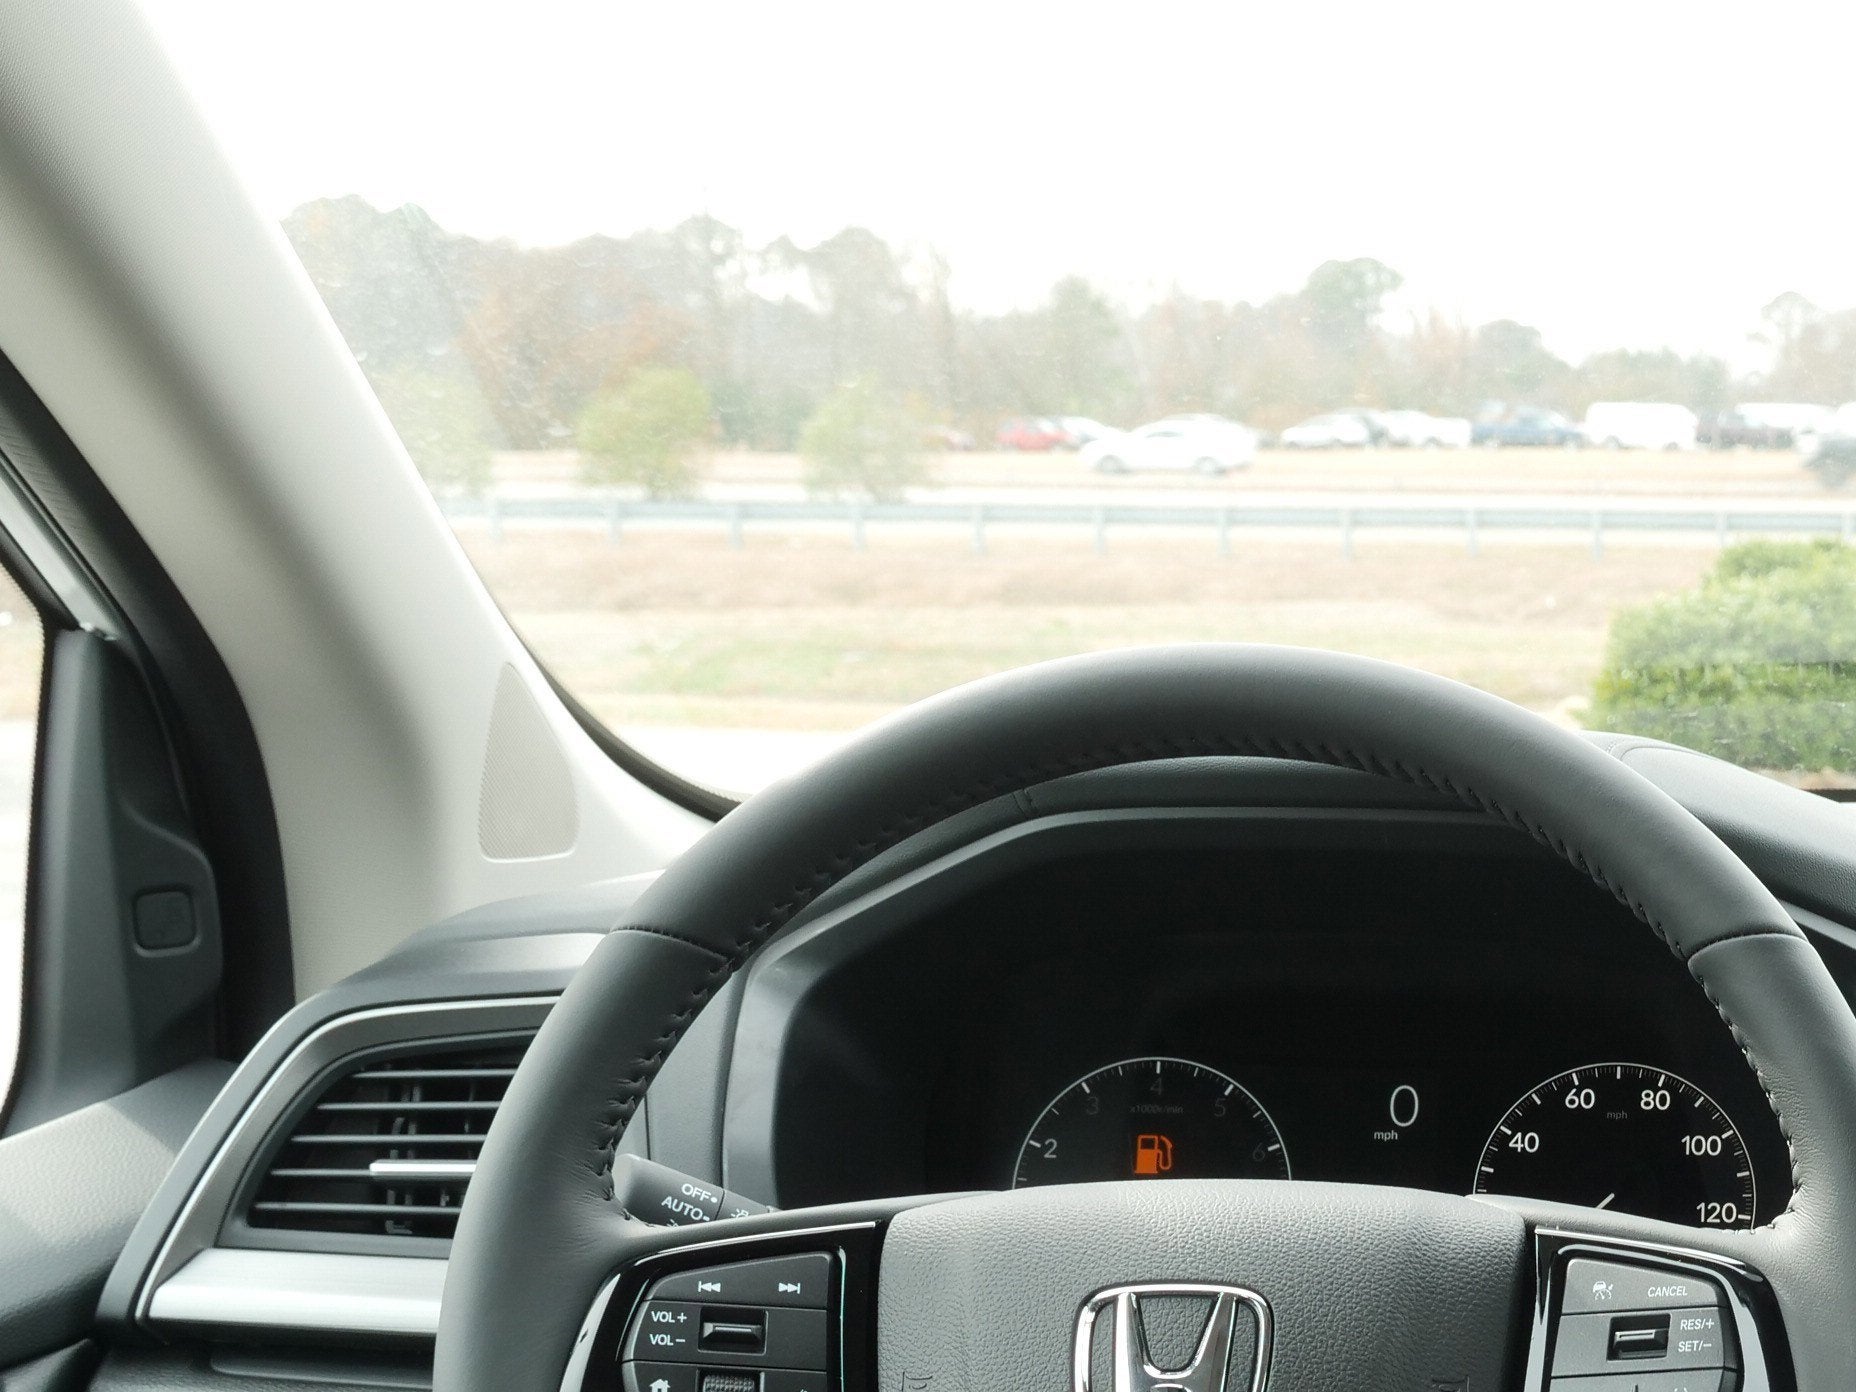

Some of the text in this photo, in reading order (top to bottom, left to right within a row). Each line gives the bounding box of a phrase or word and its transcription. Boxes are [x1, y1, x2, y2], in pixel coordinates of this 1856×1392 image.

[1150, 1077, 1164, 1096] 4
[1086, 1096, 1099, 1116] 3
[1213, 1097, 1227, 1117] 5
[1389, 1084, 1420, 1128] 0
[1564, 1087, 1596, 1110] 60
[1639, 1088, 1671, 1112] 80
[1606, 1109, 1628, 1122] mph
[1373, 1129, 1398, 1143] mph
[1508, 1131, 1540, 1154] 40
[1680, 1134, 1723, 1157] 100
[1043, 1137, 1058, 1159] 2
[680, 1182, 712, 1203] OFF
[661, 1195, 704, 1222] AUTO
[1695, 1201, 1738, 1224] 120
[1647, 1285, 1688, 1298] CANCEL
